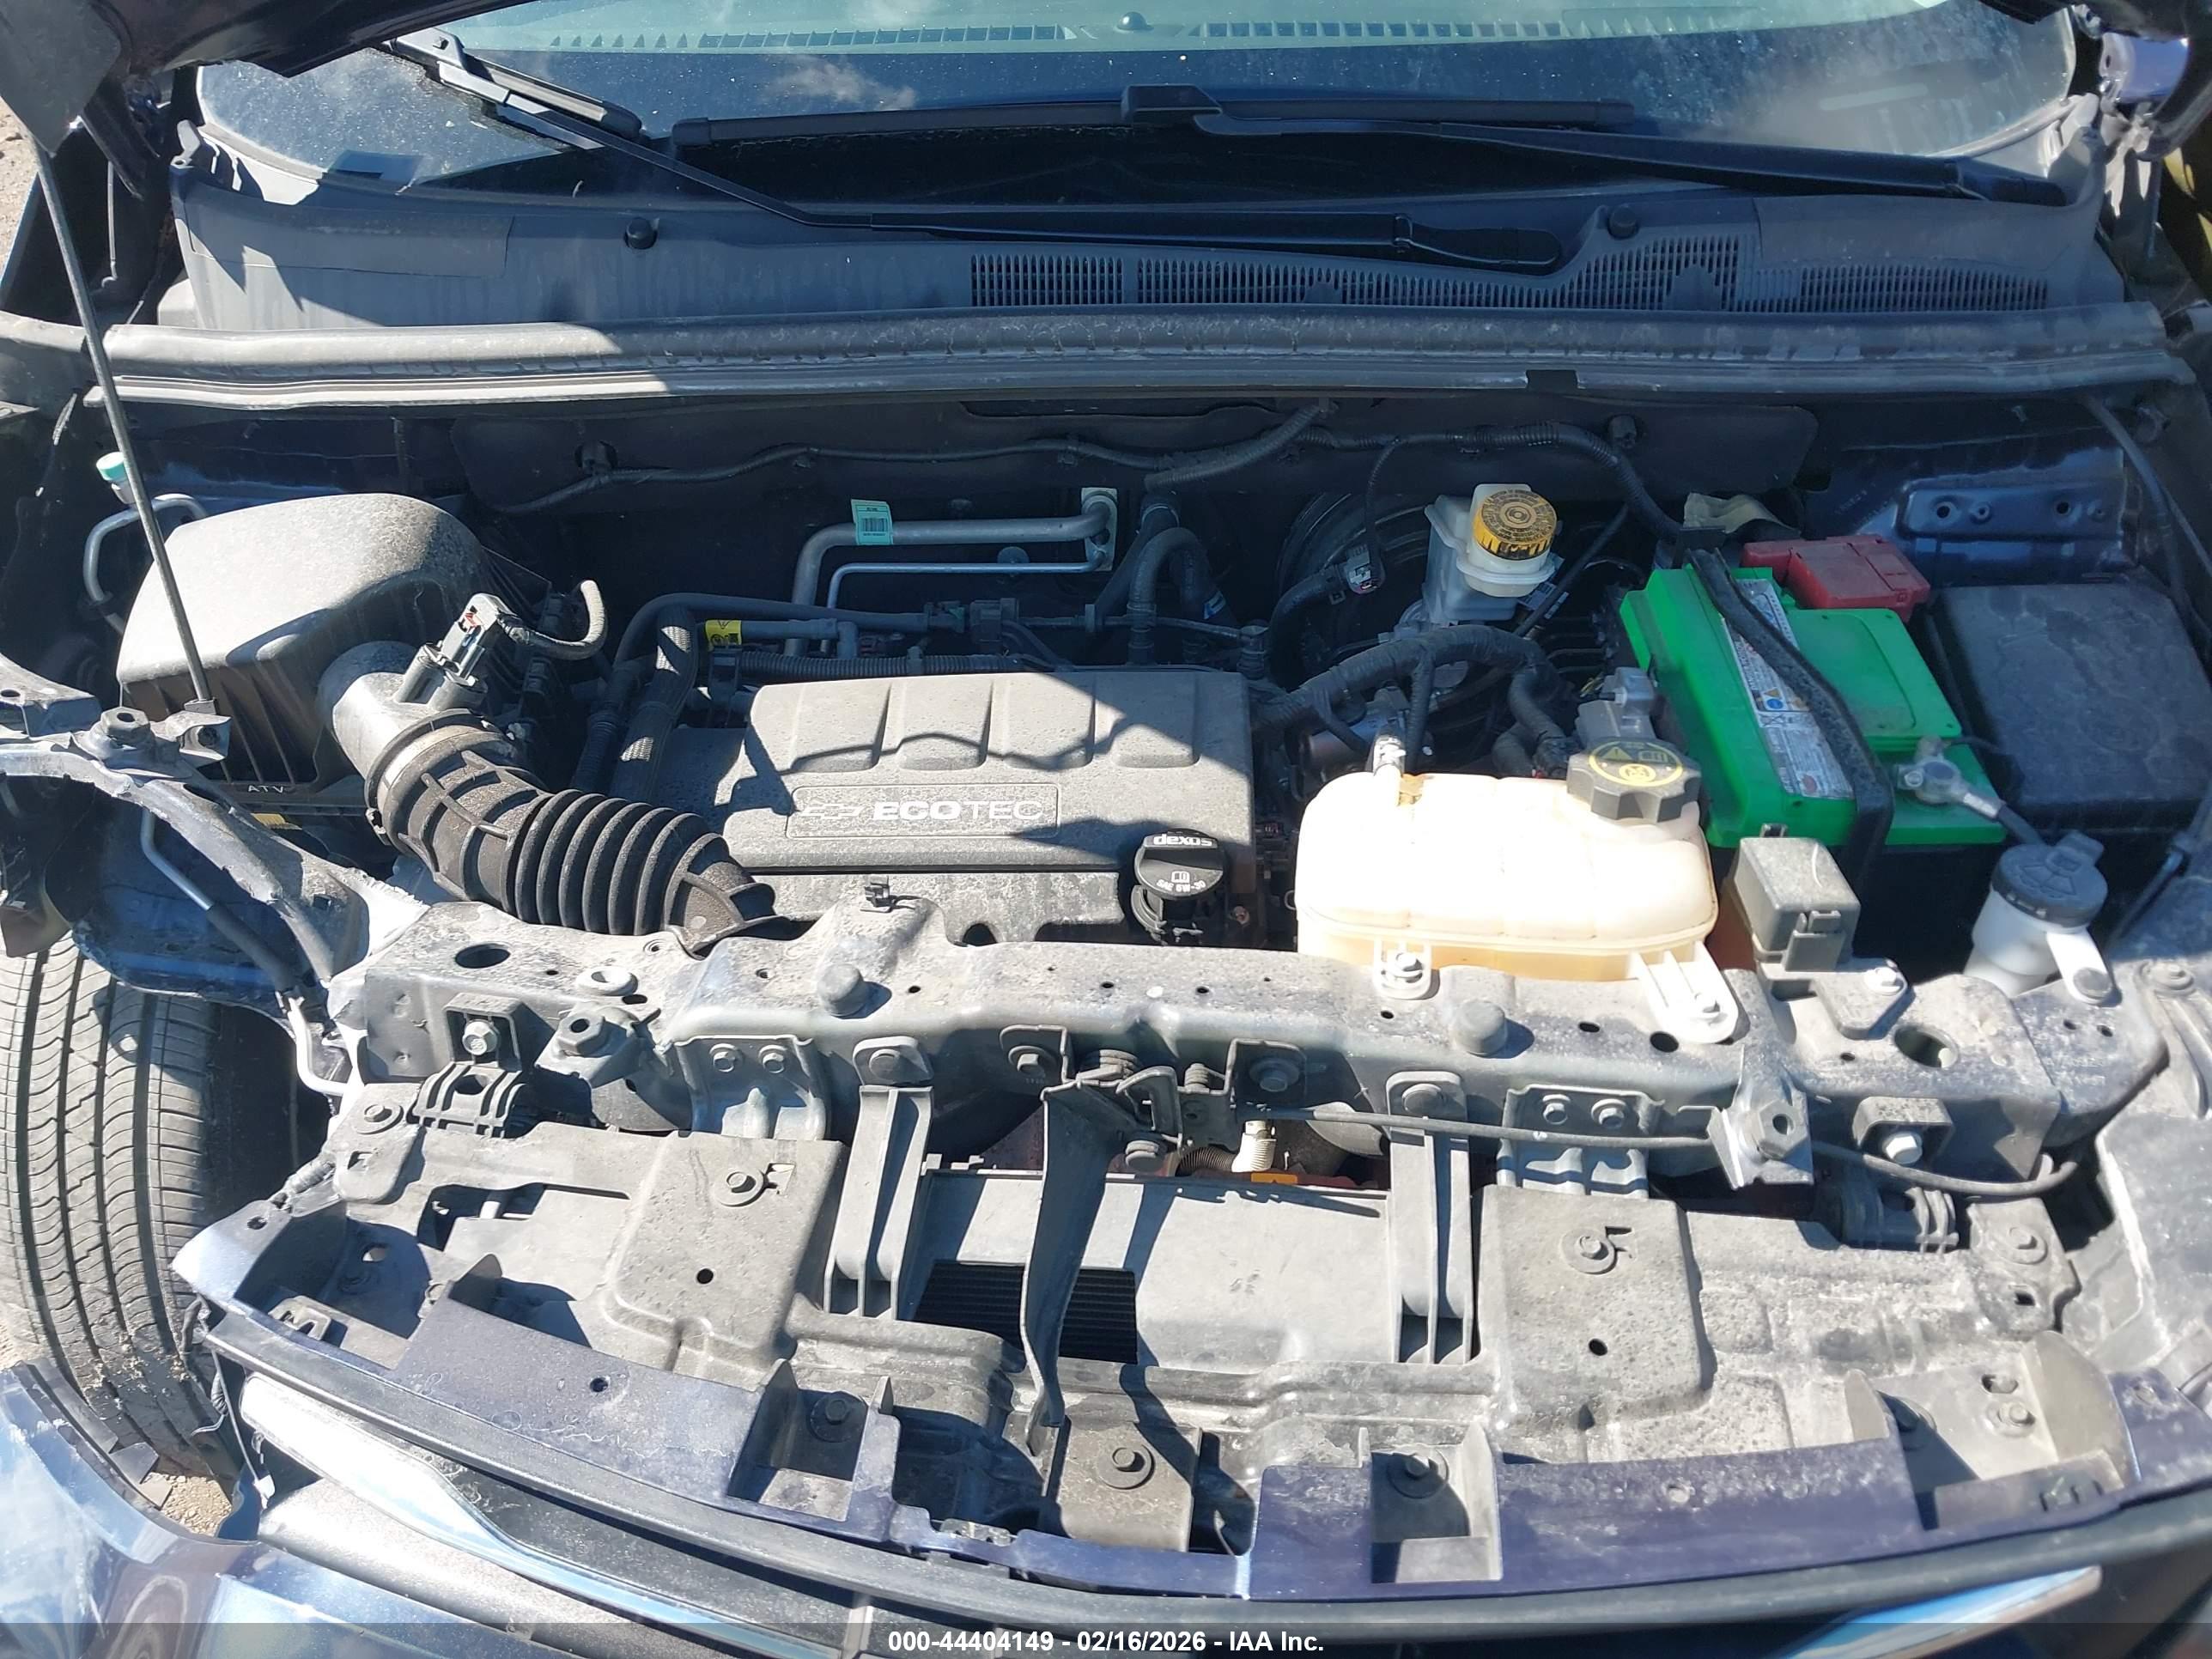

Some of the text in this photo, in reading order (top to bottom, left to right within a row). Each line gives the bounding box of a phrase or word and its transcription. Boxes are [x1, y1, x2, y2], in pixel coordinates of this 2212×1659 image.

[872, 800, 1042, 820] ECOTEC
[1153, 834, 1212, 846] dexos
[1156, 879, 1175, 891] SAE
